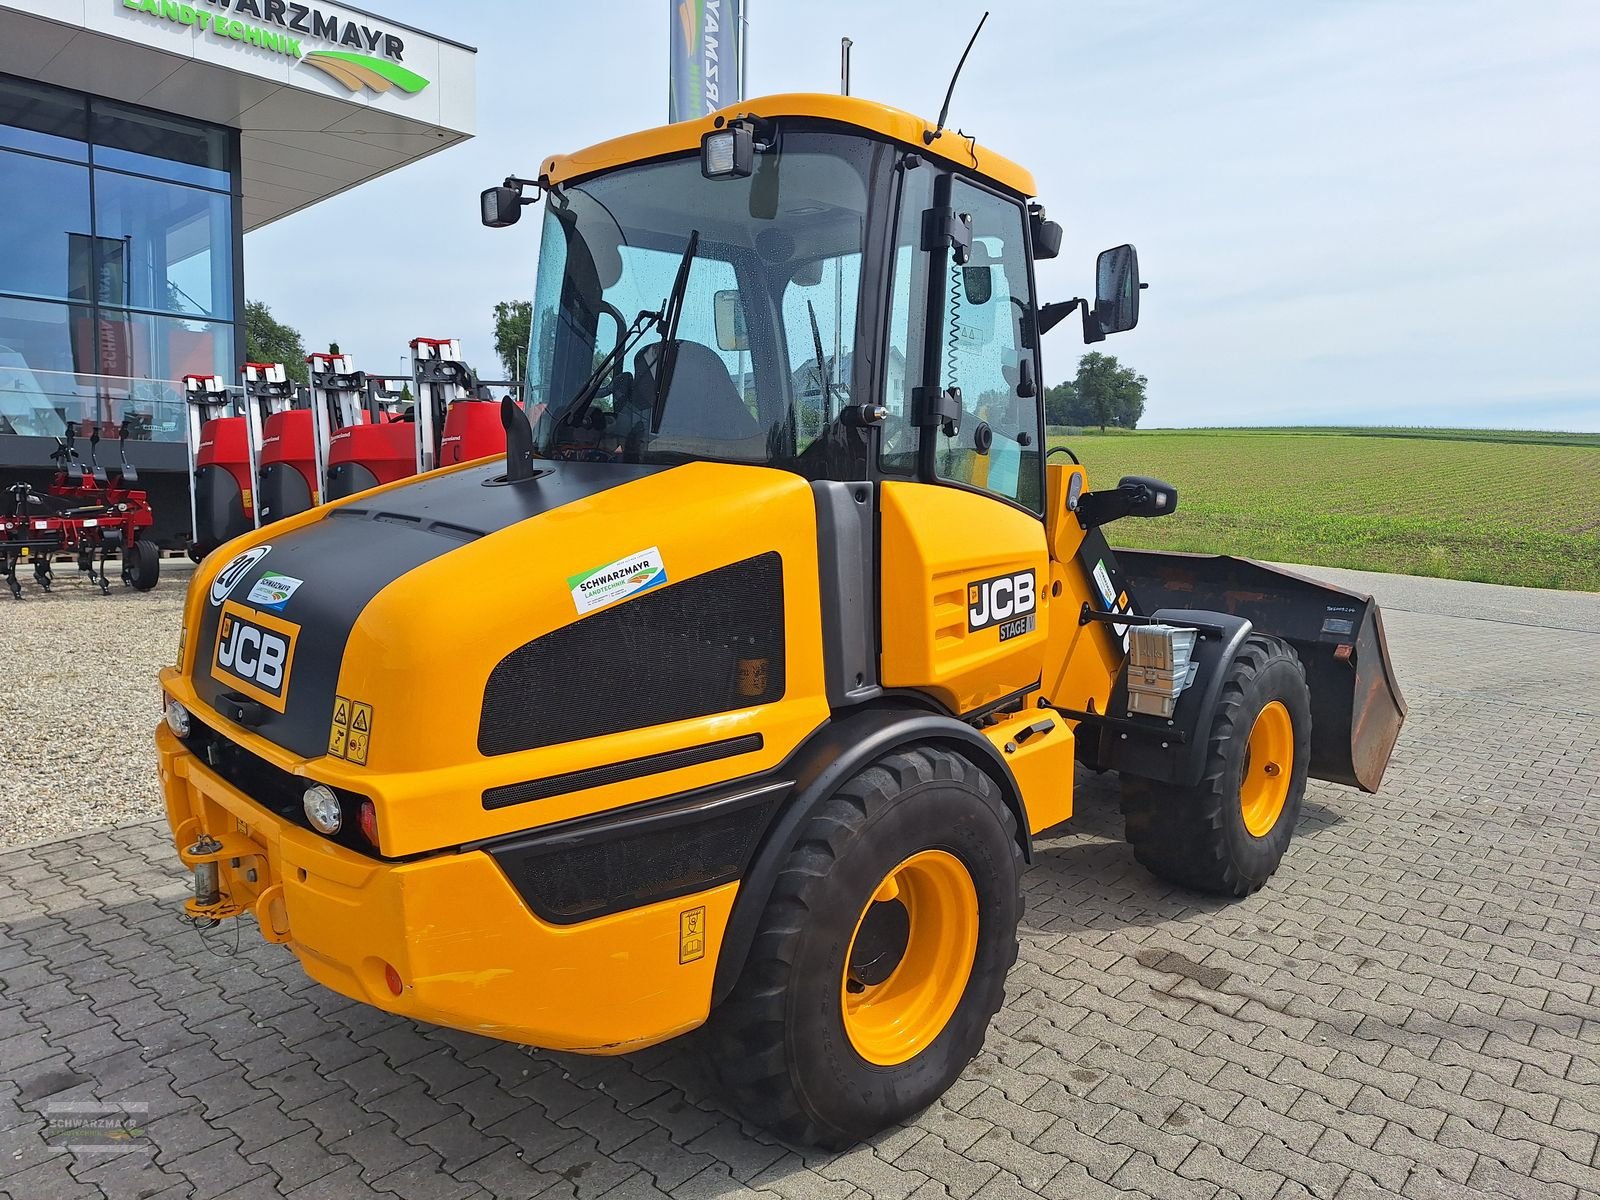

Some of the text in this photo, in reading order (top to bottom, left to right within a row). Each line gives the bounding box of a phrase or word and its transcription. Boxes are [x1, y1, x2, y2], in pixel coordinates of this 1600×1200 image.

[206, 0, 405, 61] ARZMAYR
[216, 555, 255, 588] 20
[580, 560, 650, 592] SCHWARZMAYR
[584, 579, 626, 599] LANDTECHNIK
[969, 572, 1035, 627] JCB
[1000, 619, 1026, 640] STAGE
[219, 621, 286, 689] JCB
